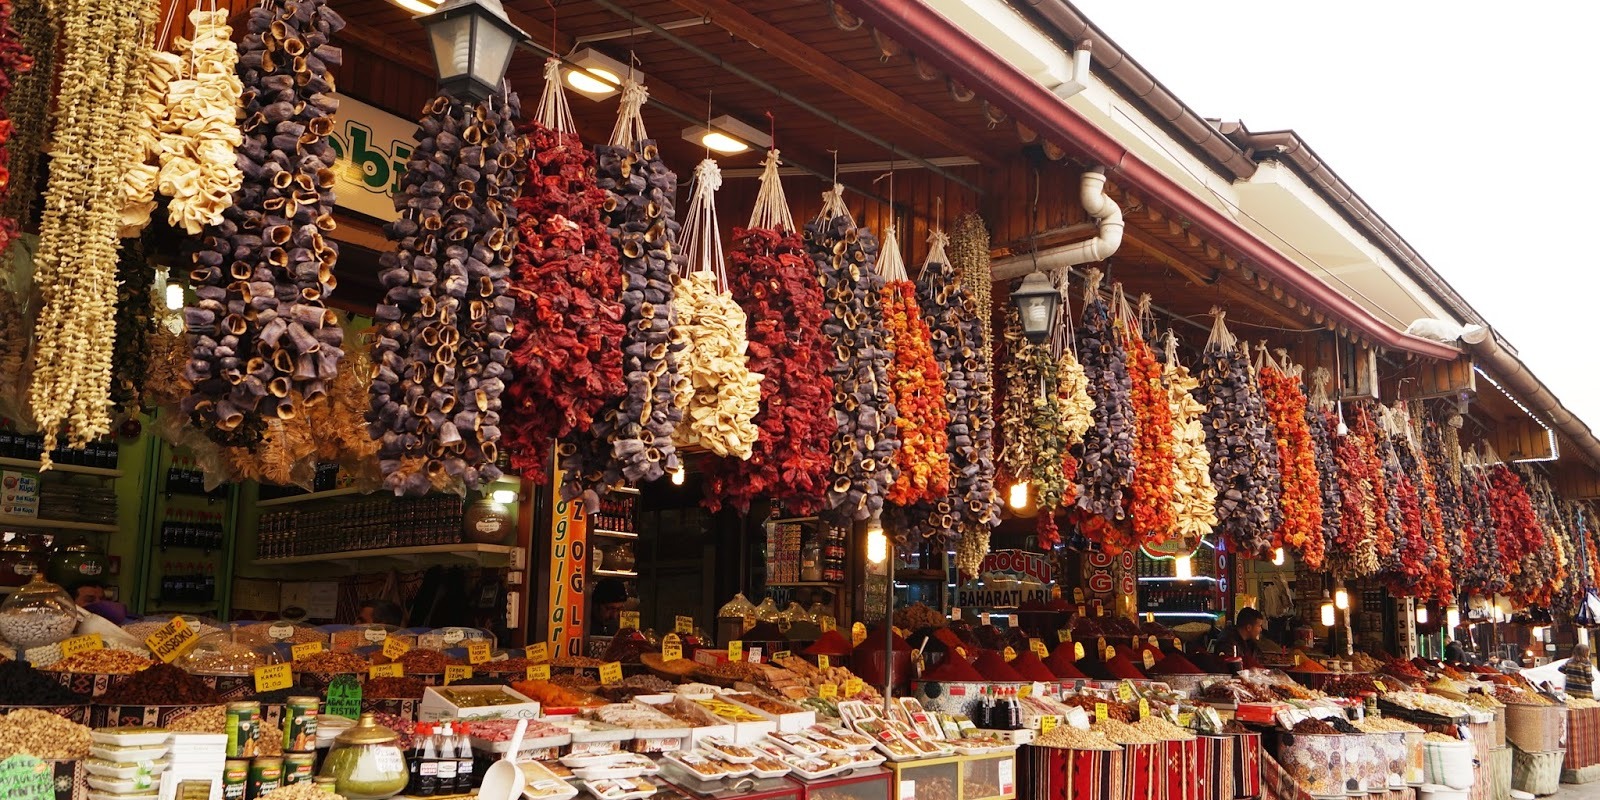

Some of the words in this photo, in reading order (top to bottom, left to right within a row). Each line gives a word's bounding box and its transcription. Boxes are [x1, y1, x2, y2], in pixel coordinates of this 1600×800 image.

[960, 589, 1050, 607] BAHARATLARI
[156, 627, 194, 658] KUŞBOKU
[262, 681, 282, 689] 12.00
[330, 707, 358, 716] FISTIK
